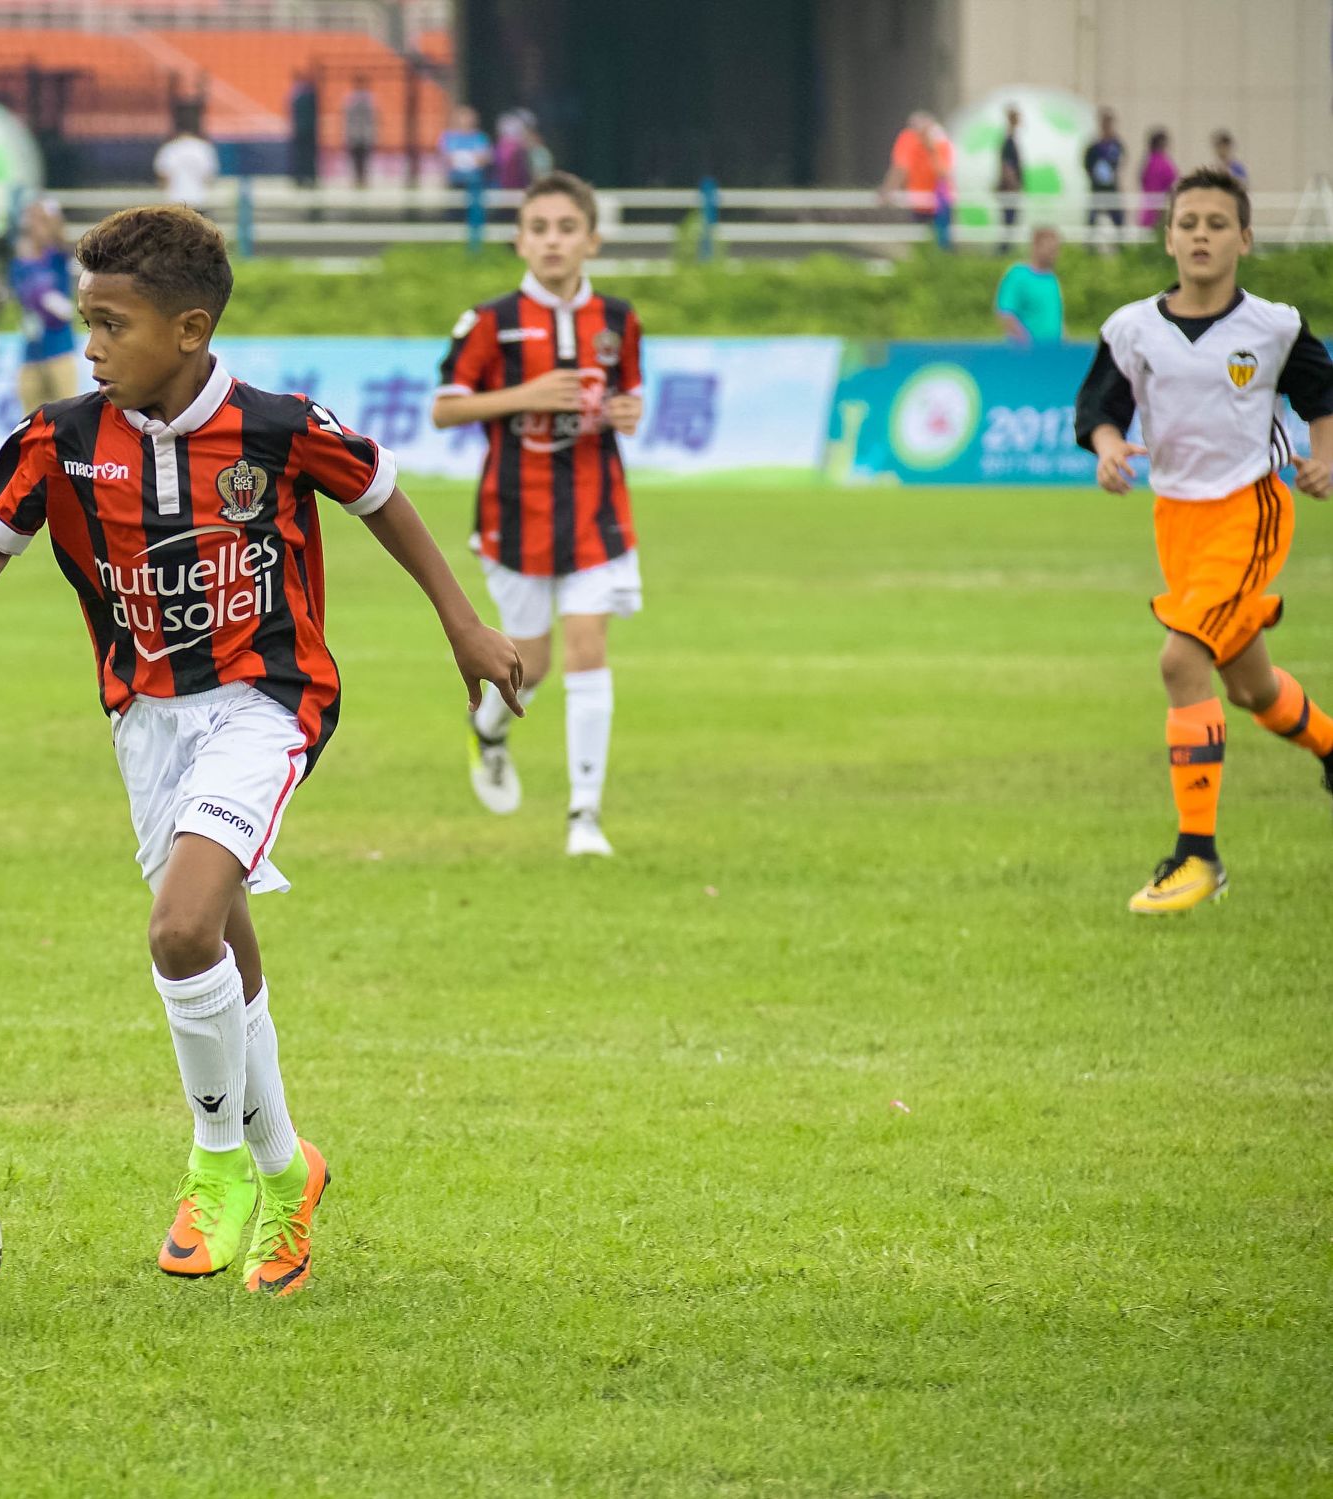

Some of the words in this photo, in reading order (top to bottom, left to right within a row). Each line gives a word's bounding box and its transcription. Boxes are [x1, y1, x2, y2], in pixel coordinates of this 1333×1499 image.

[64, 461, 128, 480] macron
[233, 476, 253, 484] OGC
[94, 535, 278, 596] mutuelles
[112, 596, 154, 632] du
[163, 571, 272, 632] soleil
[197, 802, 254, 838] macron
